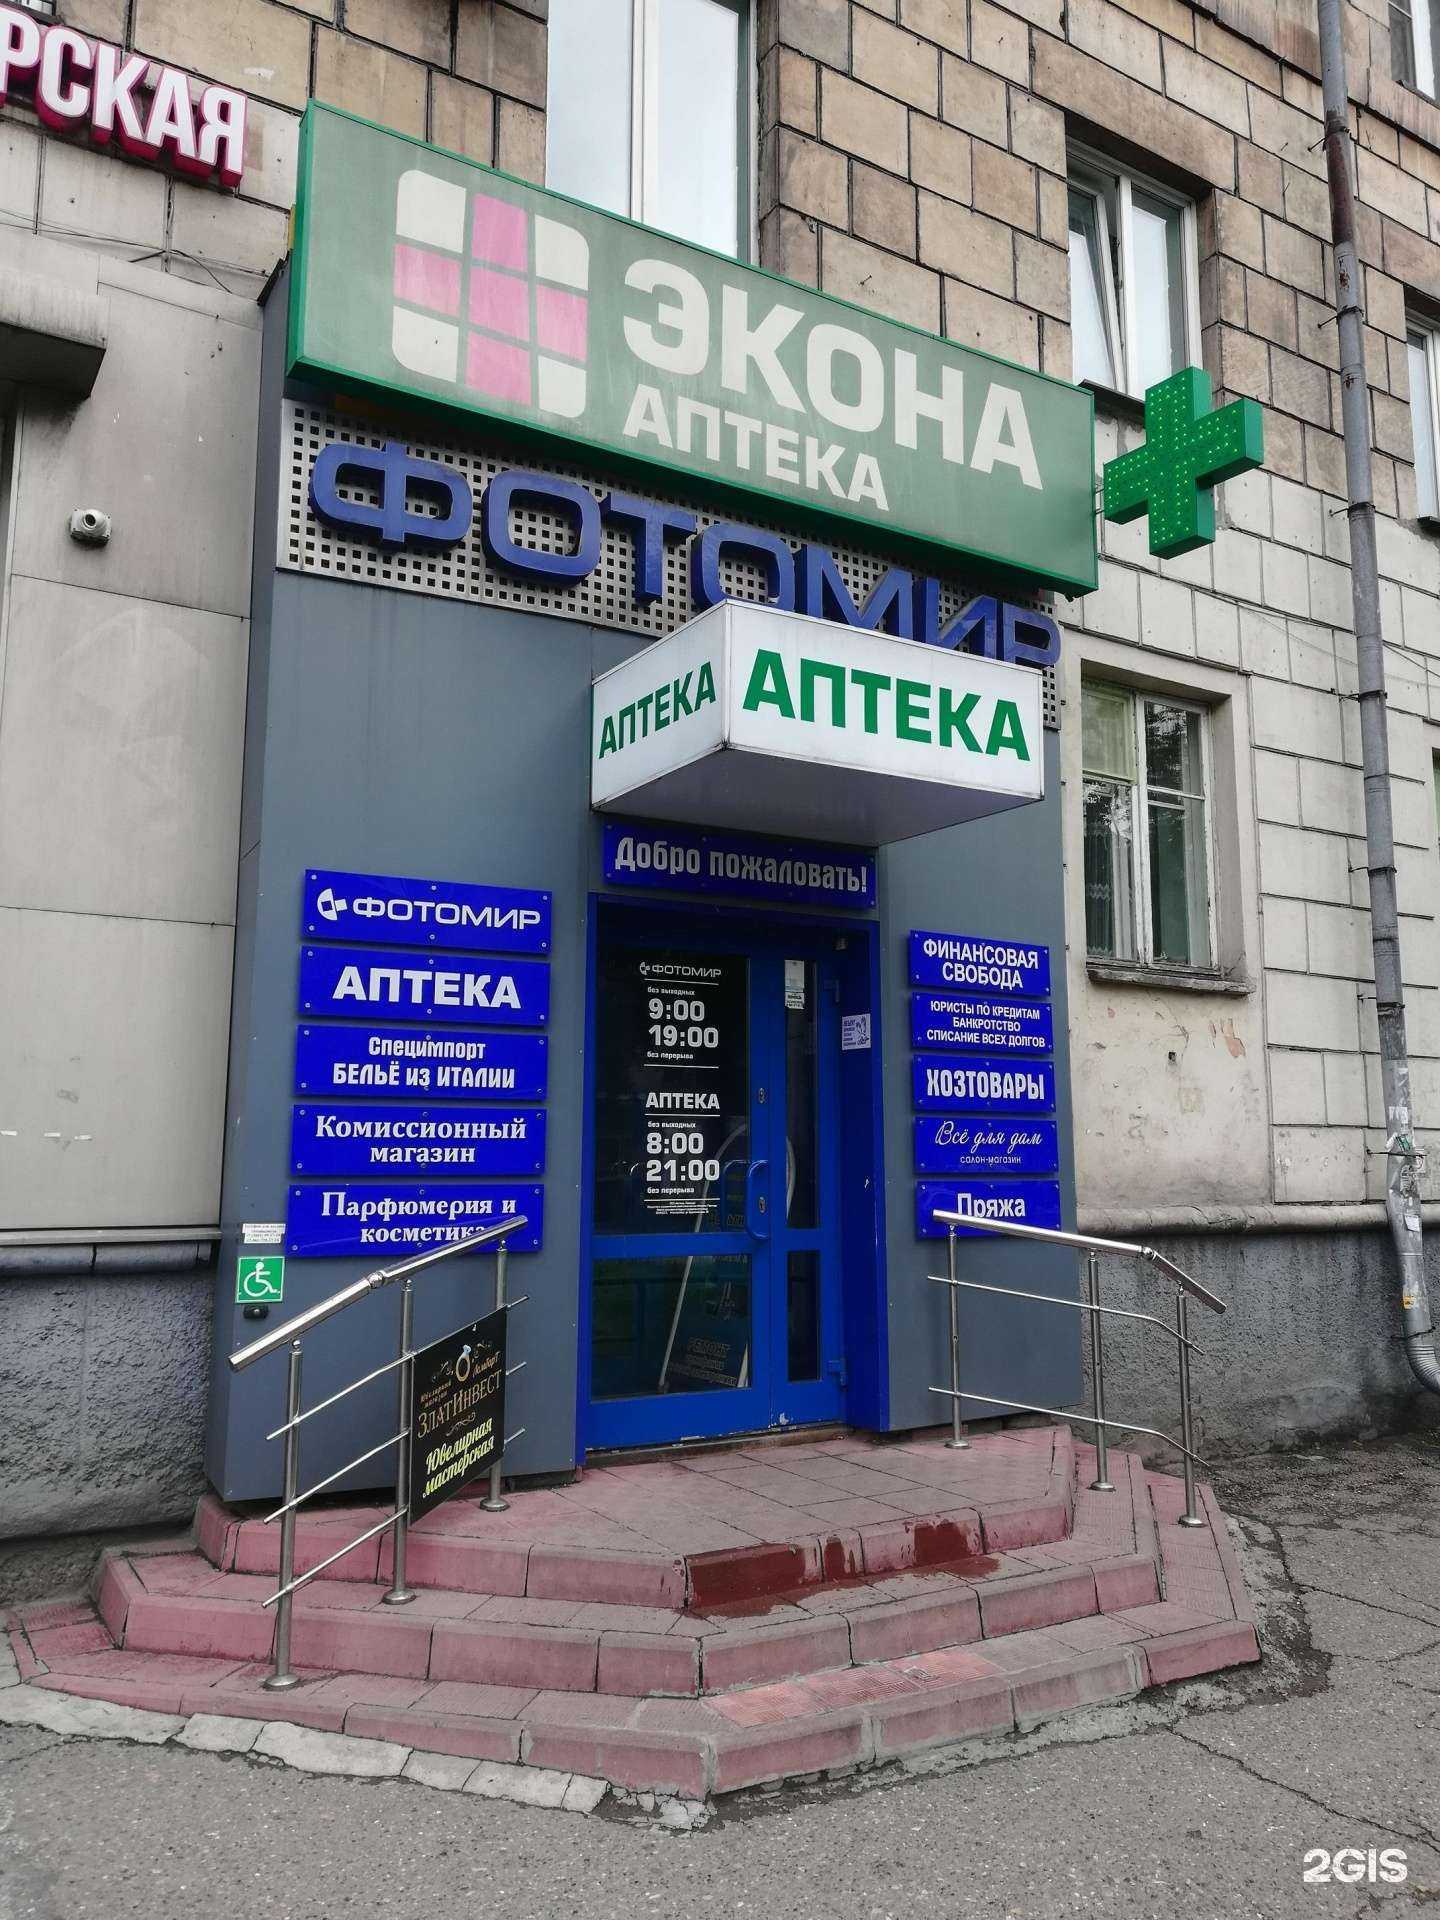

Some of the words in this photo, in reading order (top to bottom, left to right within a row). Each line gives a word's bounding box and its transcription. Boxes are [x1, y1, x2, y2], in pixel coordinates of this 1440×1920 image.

[623, 259, 1043, 490] ЭКОНА
[623, 384, 889, 511] АПТЕКА
[308, 440, 1062, 668] ФОТОМИР
[598, 661, 716, 760] АПТЕКА
[743, 648, 1030, 761] АПТЕКА
[614, 837, 701, 874] Добро
[709, 850, 867, 893] пожаловать!
[352, 896, 541, 930] ФОТОМИР
[923, 938, 1039, 969] ФИНАНСОВАЯ
[652, 964, 721, 978] ФОТОМИР
[942, 961, 1023, 990] СВОБОДА
[332, 965, 522, 1009] АПТЕКА
[648, 998, 705, 1021] 9:00
[930, 1000, 974, 1015] ЮРИСТЫ
[976, 1004, 990, 1016] ПО
[992, 1005, 1040, 1020] КРЕДИТАМ
[648, 1024, 719, 1048] 19:00
[953, 1016, 1021, 1032] БАНКРОТСТВО
[368, 1036, 486, 1060] Специмпорт
[926, 1029, 980, 1043] СПИСАНИЕ
[982, 1033, 1007, 1045] ВСЕХ
[1008, 1034, 1046, 1048] ДОЛГОВ
[333, 1061, 400, 1086] БЕЛЬЁ
[406, 1066, 431, 1086] из
[437, 1066, 515, 1088] ИТАЛИИ
[926, 1068, 1045, 1100] ХОЗТОВАРЫ
[645, 1092, 720, 1109] АПТЕКА
[315, 1115, 526, 1139] Комиссионный
[935, 1120, 969, 1146] Всё
[970, 1131, 1006, 1154] для
[1007, 1131, 1043, 1154] дам
[370, 1146, 476, 1163] магазин
[646, 1132, 704, 1154] 8:00
[646, 1159, 720, 1182] 21:00
[960, 1155, 1022, 1167] салон-магазин
[321, 1191, 492, 1222] Парфюмерия
[501, 1199, 517, 1214] и
[957, 1192, 1026, 1218] Пряжа
[425, 1417, 493, 1475] Ювелирная
[424, 1435, 495, 1496] мастерская
